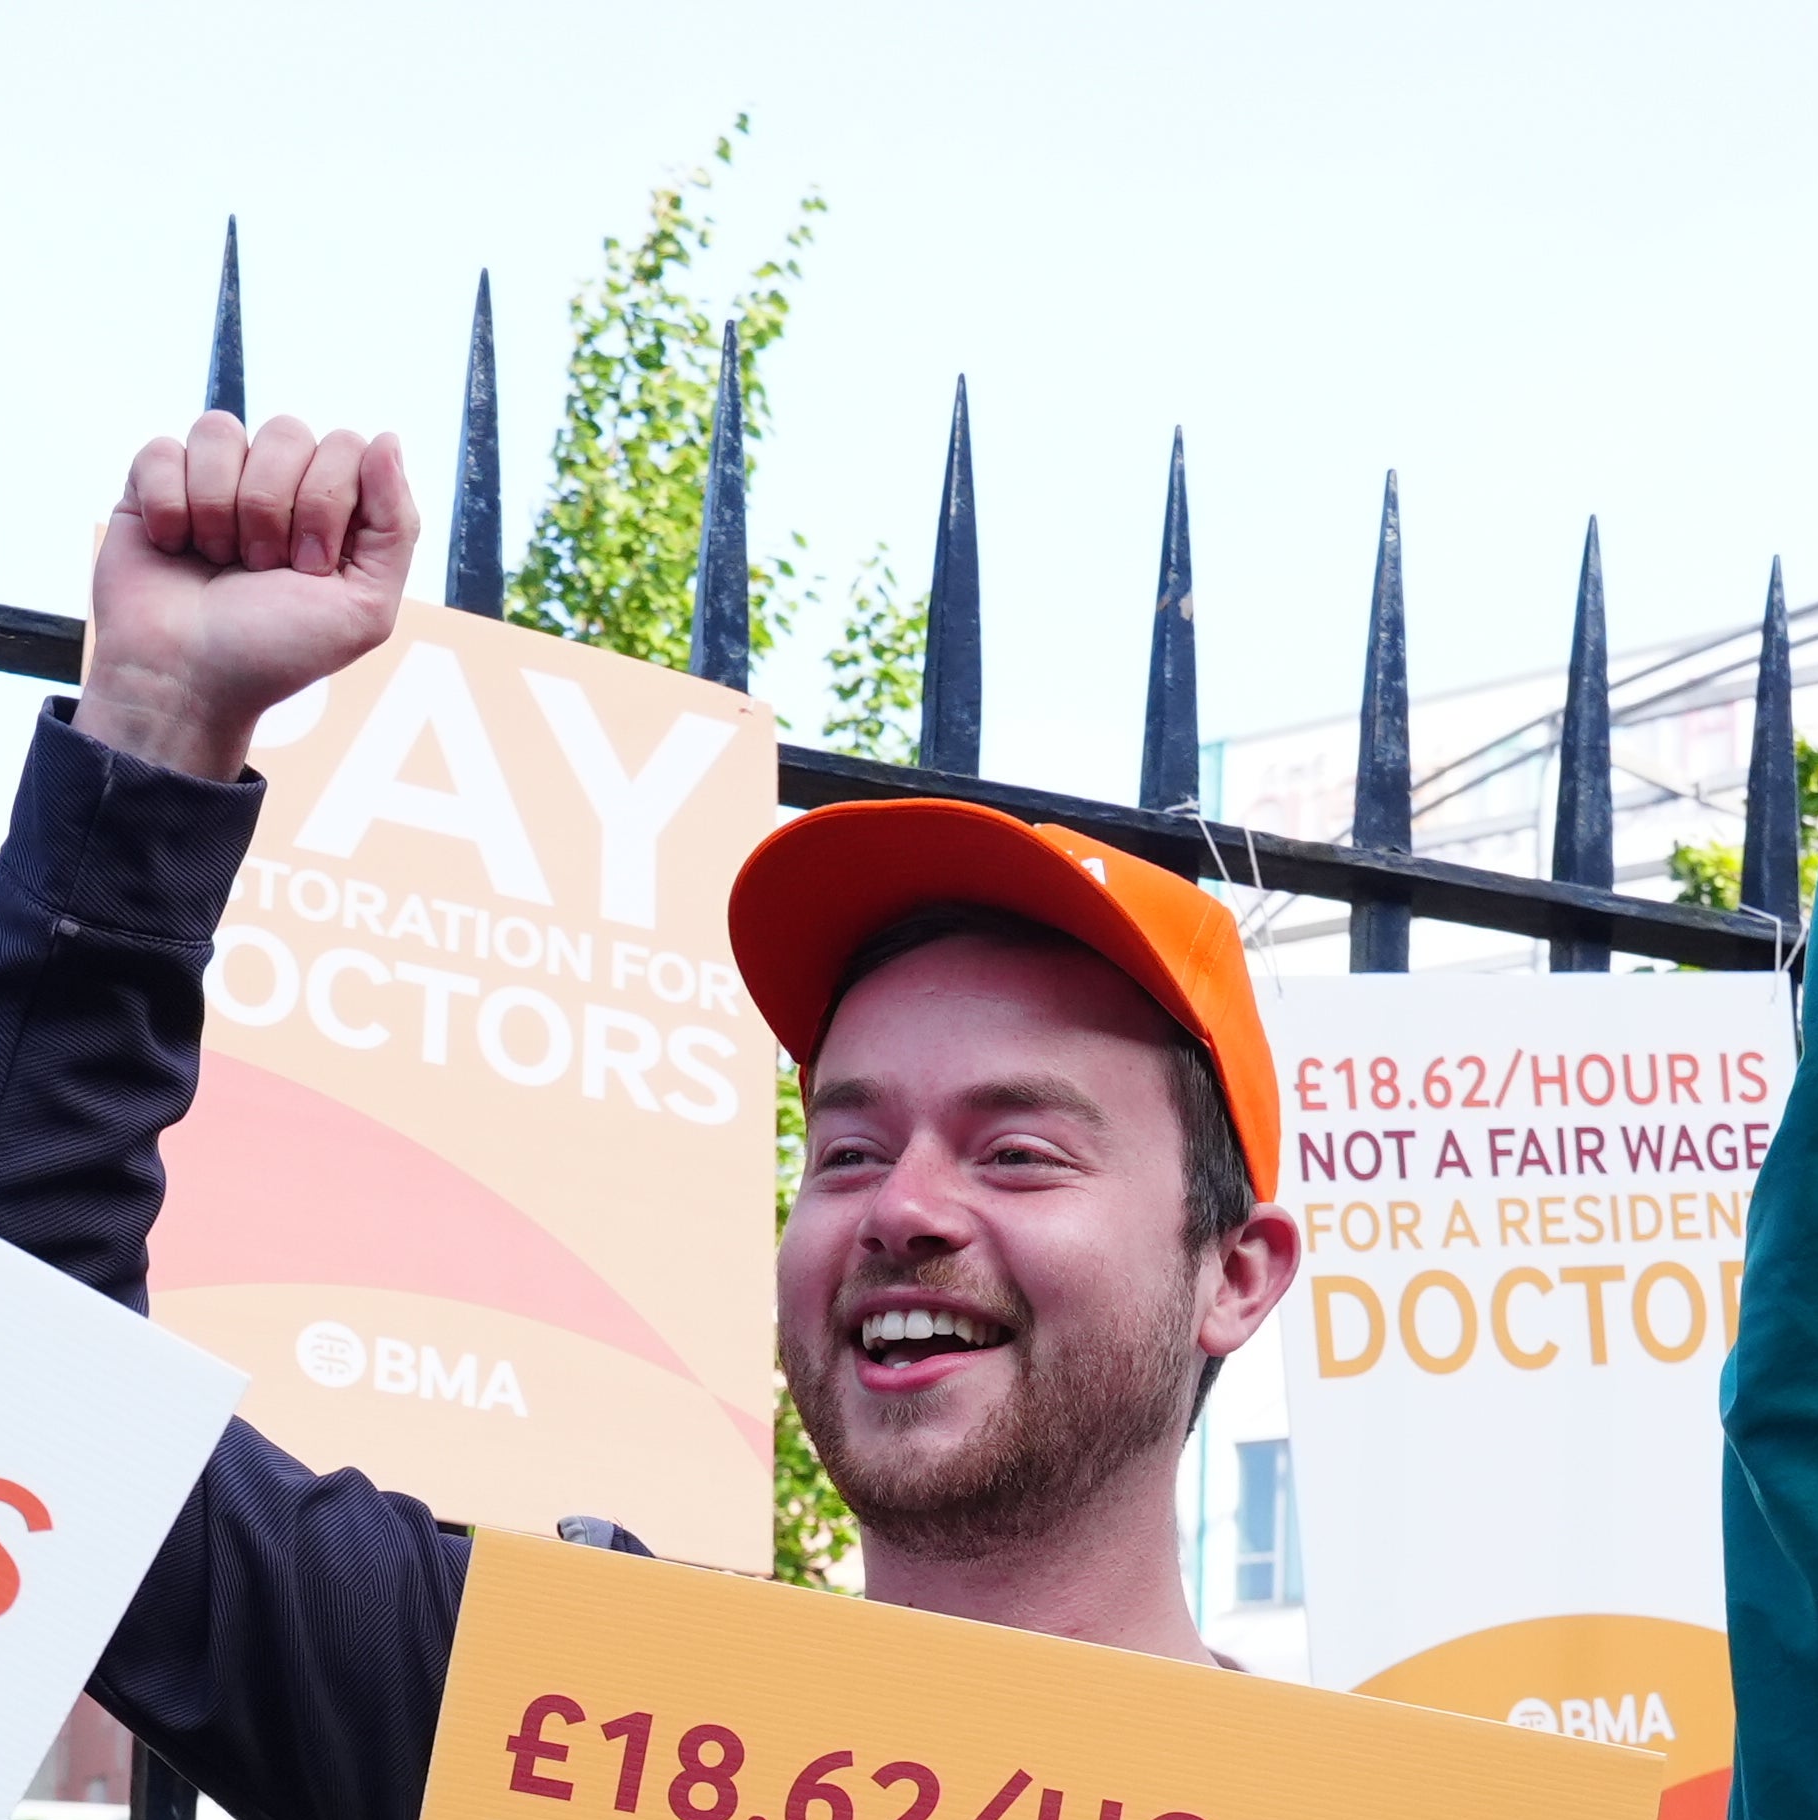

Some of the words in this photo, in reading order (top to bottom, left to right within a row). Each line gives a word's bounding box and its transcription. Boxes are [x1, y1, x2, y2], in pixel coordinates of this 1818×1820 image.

[246, 640, 739, 931] AY
[227, 856, 593, 984] TORATION
[610, 941, 741, 1017] FOR
[202, 924, 740, 1127] OCTORS
[1293, 1048, 1703, 1113] £18.62/HOUR
[1719, 1051, 1770, 1104] IS
[1297, 1129, 1417, 1183] NOT
[1434, 1129, 1473, 1179] A
[1487, 1126, 1608, 1178] FAIR
[1619, 1122, 1771, 1174] WAGE
[1303, 1201, 1425, 1254] FOR
[1440, 1199, 1482, 1249] A
[1496, 1190, 1755, 1247] RESIDEN
[374, 1335, 529, 1418] BMA
[1560, 1691, 1676, 1746] BMA
